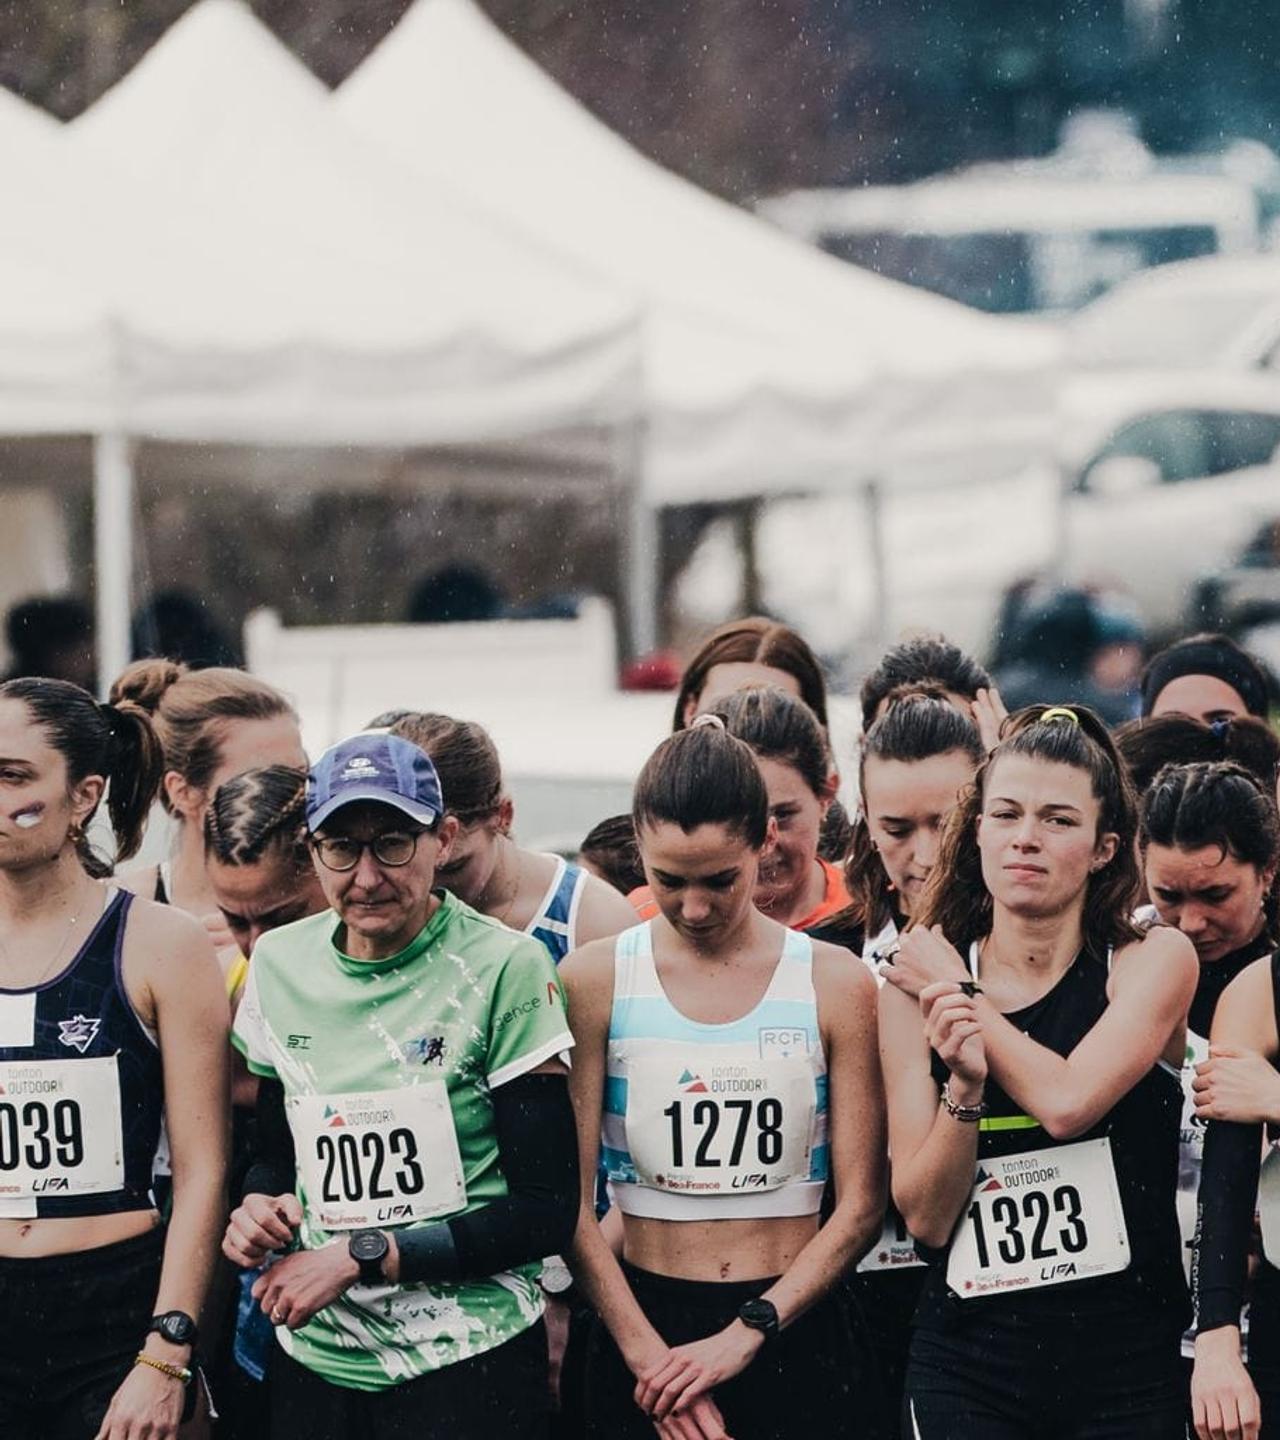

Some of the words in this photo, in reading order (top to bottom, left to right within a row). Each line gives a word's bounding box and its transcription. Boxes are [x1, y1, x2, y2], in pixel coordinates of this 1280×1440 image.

[764, 1032, 803, 1045] RCF
[8, 1080, 58, 1095] OUTDOOR
[711, 1078, 762, 1093] OUTDOOR
[664, 1097, 784, 1168] 1278
[316, 1127, 425, 1203] 2023
[1001, 1158, 1039, 1173] tonton
[33, 1177, 70, 1192] LIFA
[731, 1173, 768, 1188] LIFA
[1004, 1167, 1055, 1189] OUTDOOR
[377, 1204, 414, 1221] LIFA
[967, 1184, 1088, 1269] 1323
[1041, 1262, 1077, 1282] LIFA
